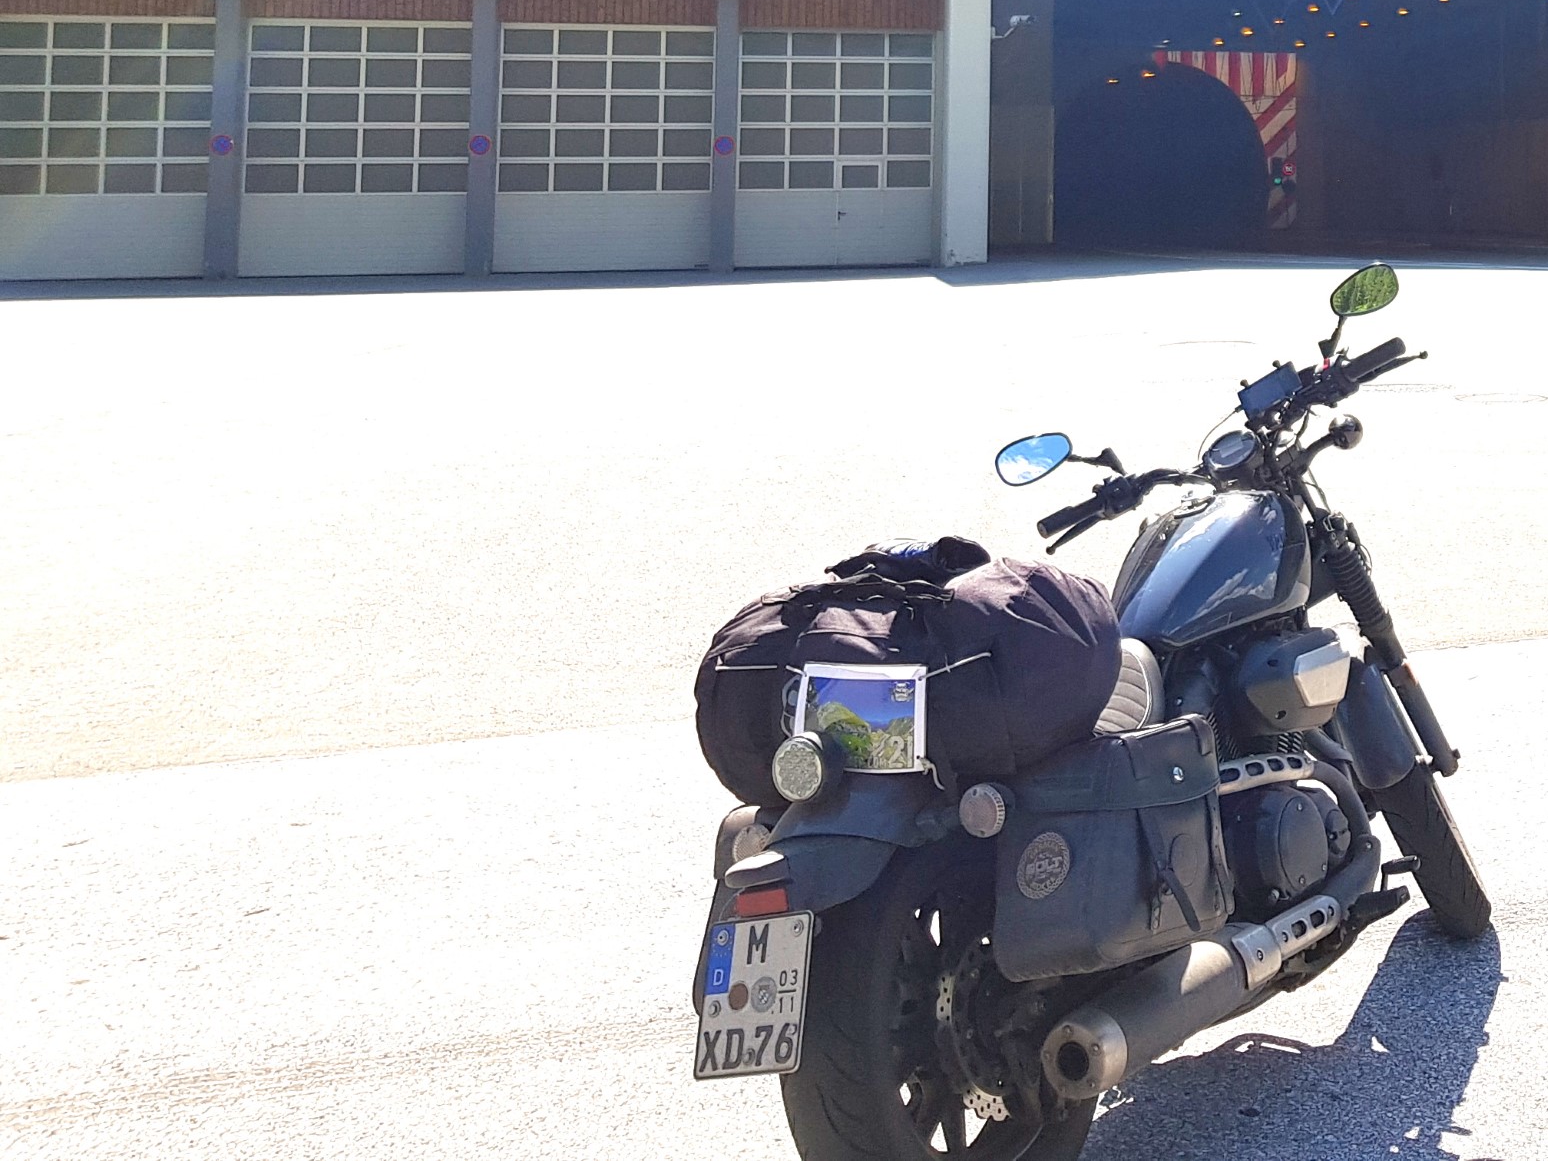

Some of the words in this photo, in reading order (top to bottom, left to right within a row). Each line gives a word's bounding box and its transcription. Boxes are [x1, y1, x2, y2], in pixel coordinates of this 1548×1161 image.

[746, 923, 770, 965] M
[713, 968, 724, 986] D
[779, 970, 798, 986] 03
